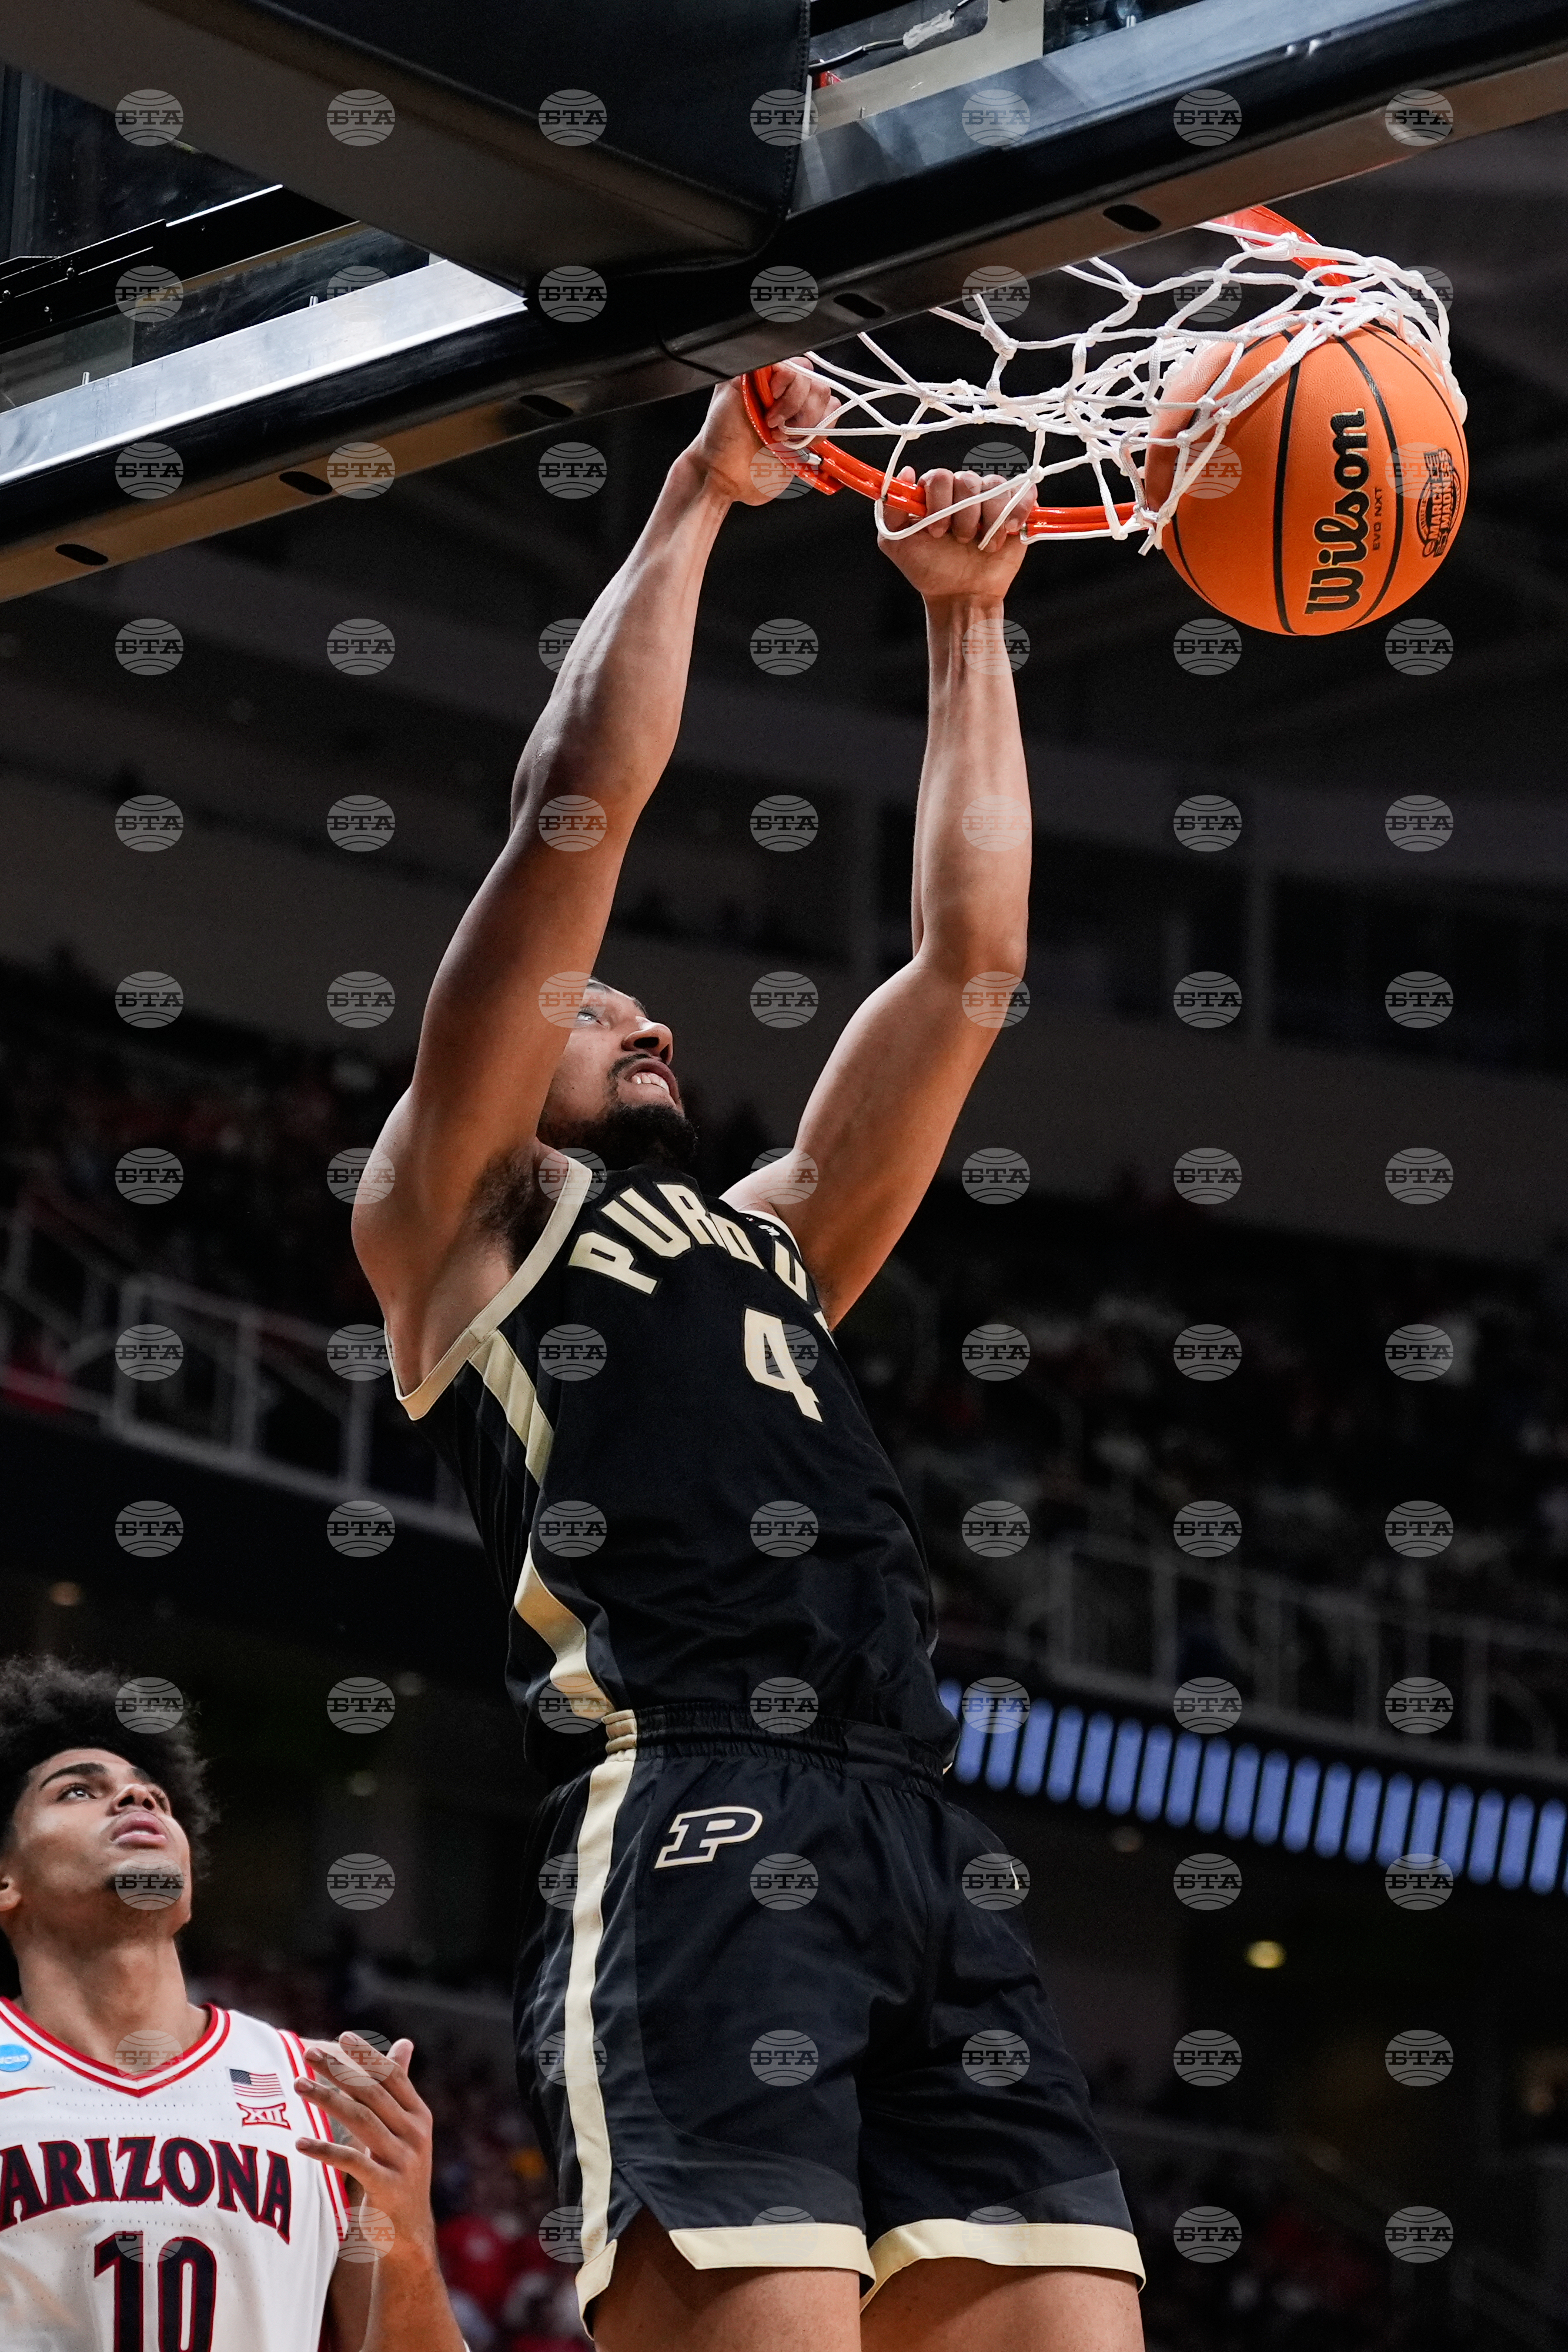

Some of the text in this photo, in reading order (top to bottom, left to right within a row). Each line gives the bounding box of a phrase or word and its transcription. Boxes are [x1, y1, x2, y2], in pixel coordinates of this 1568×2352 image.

[1303, 408, 1370, 615] Wilson
[1372, 486, 1382, 550] EVO NXT
[1427, 482, 1442, 540] MARCH
[1438, 449, 1453, 529] MADNESS
[744, 1306, 823, 1423] 4
[654, 1806, 763, 1869] P
[236, 2102, 292, 2130] XII
[0, 2136, 292, 2245] ARIZONA
[94, 2230, 217, 2352] 10
